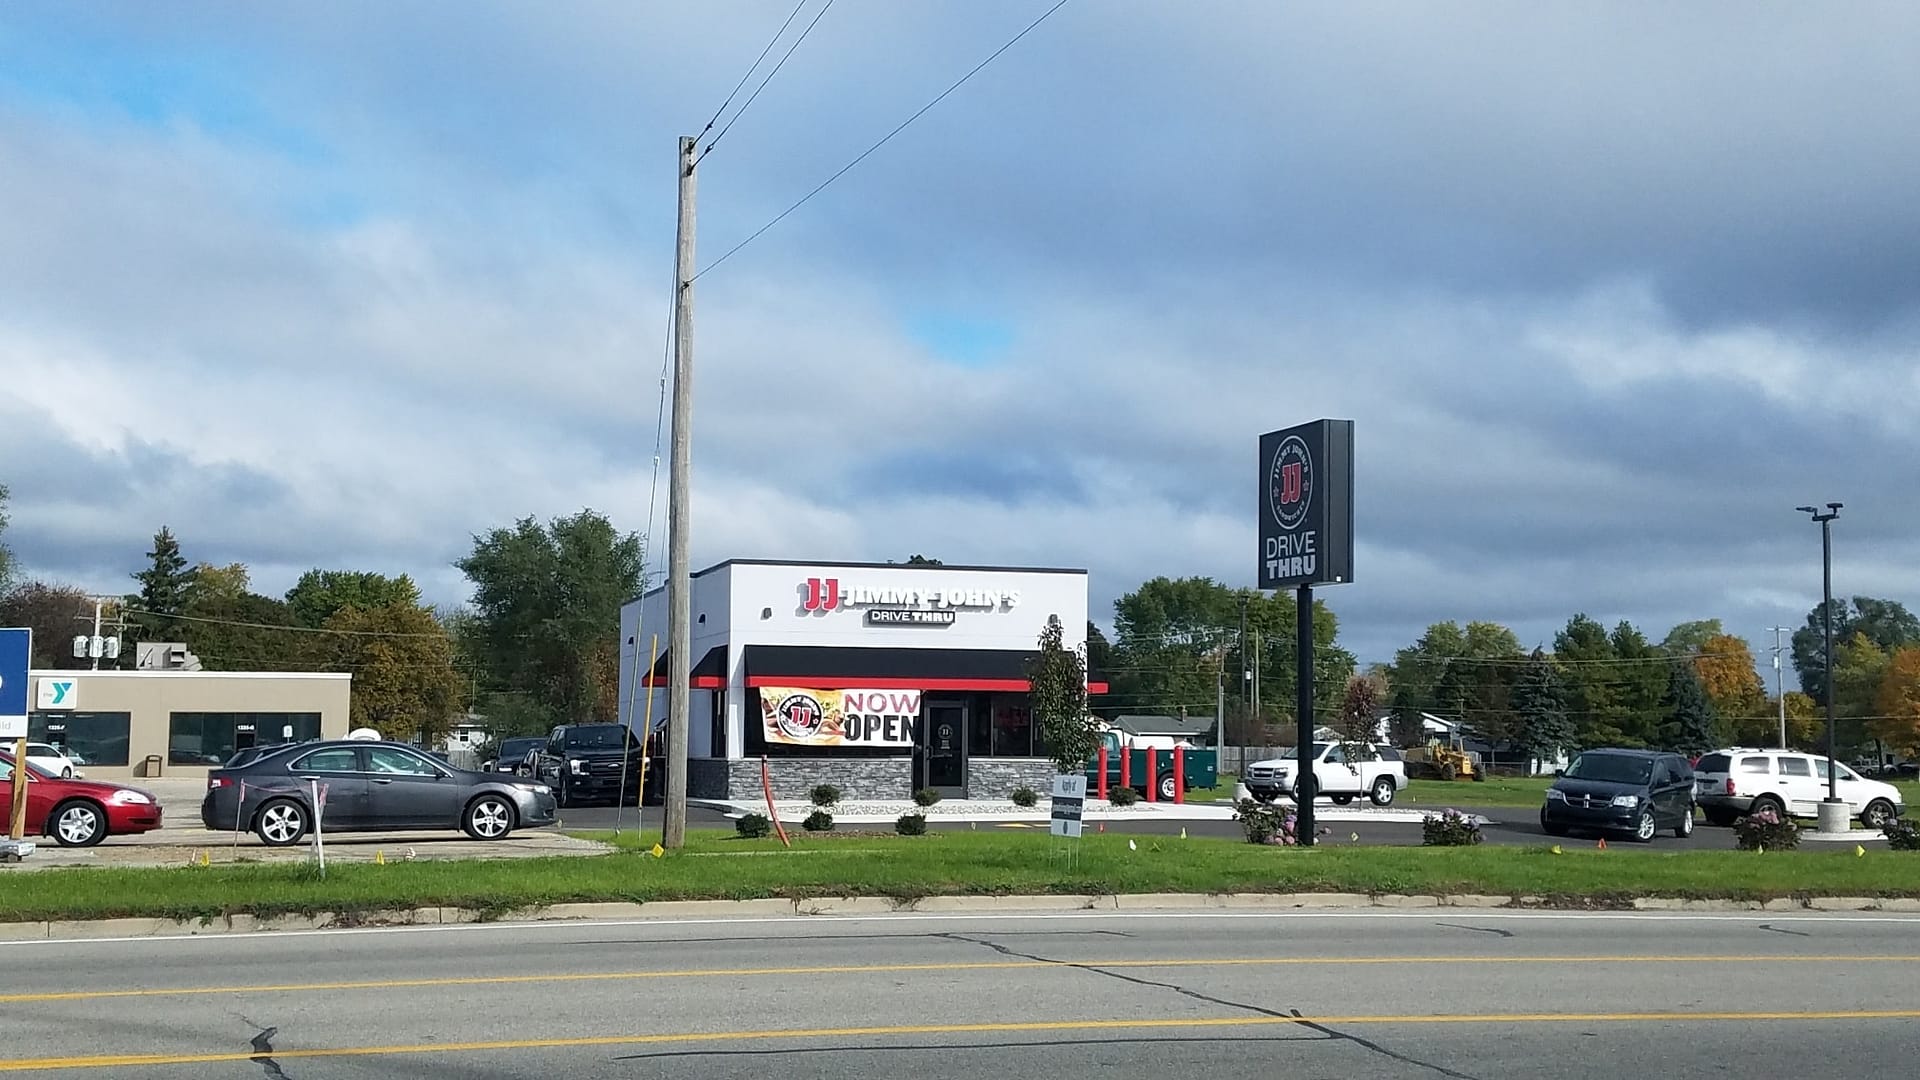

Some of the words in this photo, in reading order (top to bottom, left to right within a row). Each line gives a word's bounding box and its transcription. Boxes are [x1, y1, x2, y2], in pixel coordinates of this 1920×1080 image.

[1281, 462, 1302, 505] JJ
[1266, 530, 1316, 559] DRIVE
[1266, 554, 1316, 580] THRU
[804, 577, 840, 611] JJ
[842, 585, 933, 611] JIMMY
[937, 588, 1022, 609] JOHN'S
[871, 610, 911, 622] DRIVE
[911, 611, 954, 623] THRU
[790, 705, 812, 728] JJ
[844, 693, 921, 713] NOW
[844, 714, 918, 742] OPEN
